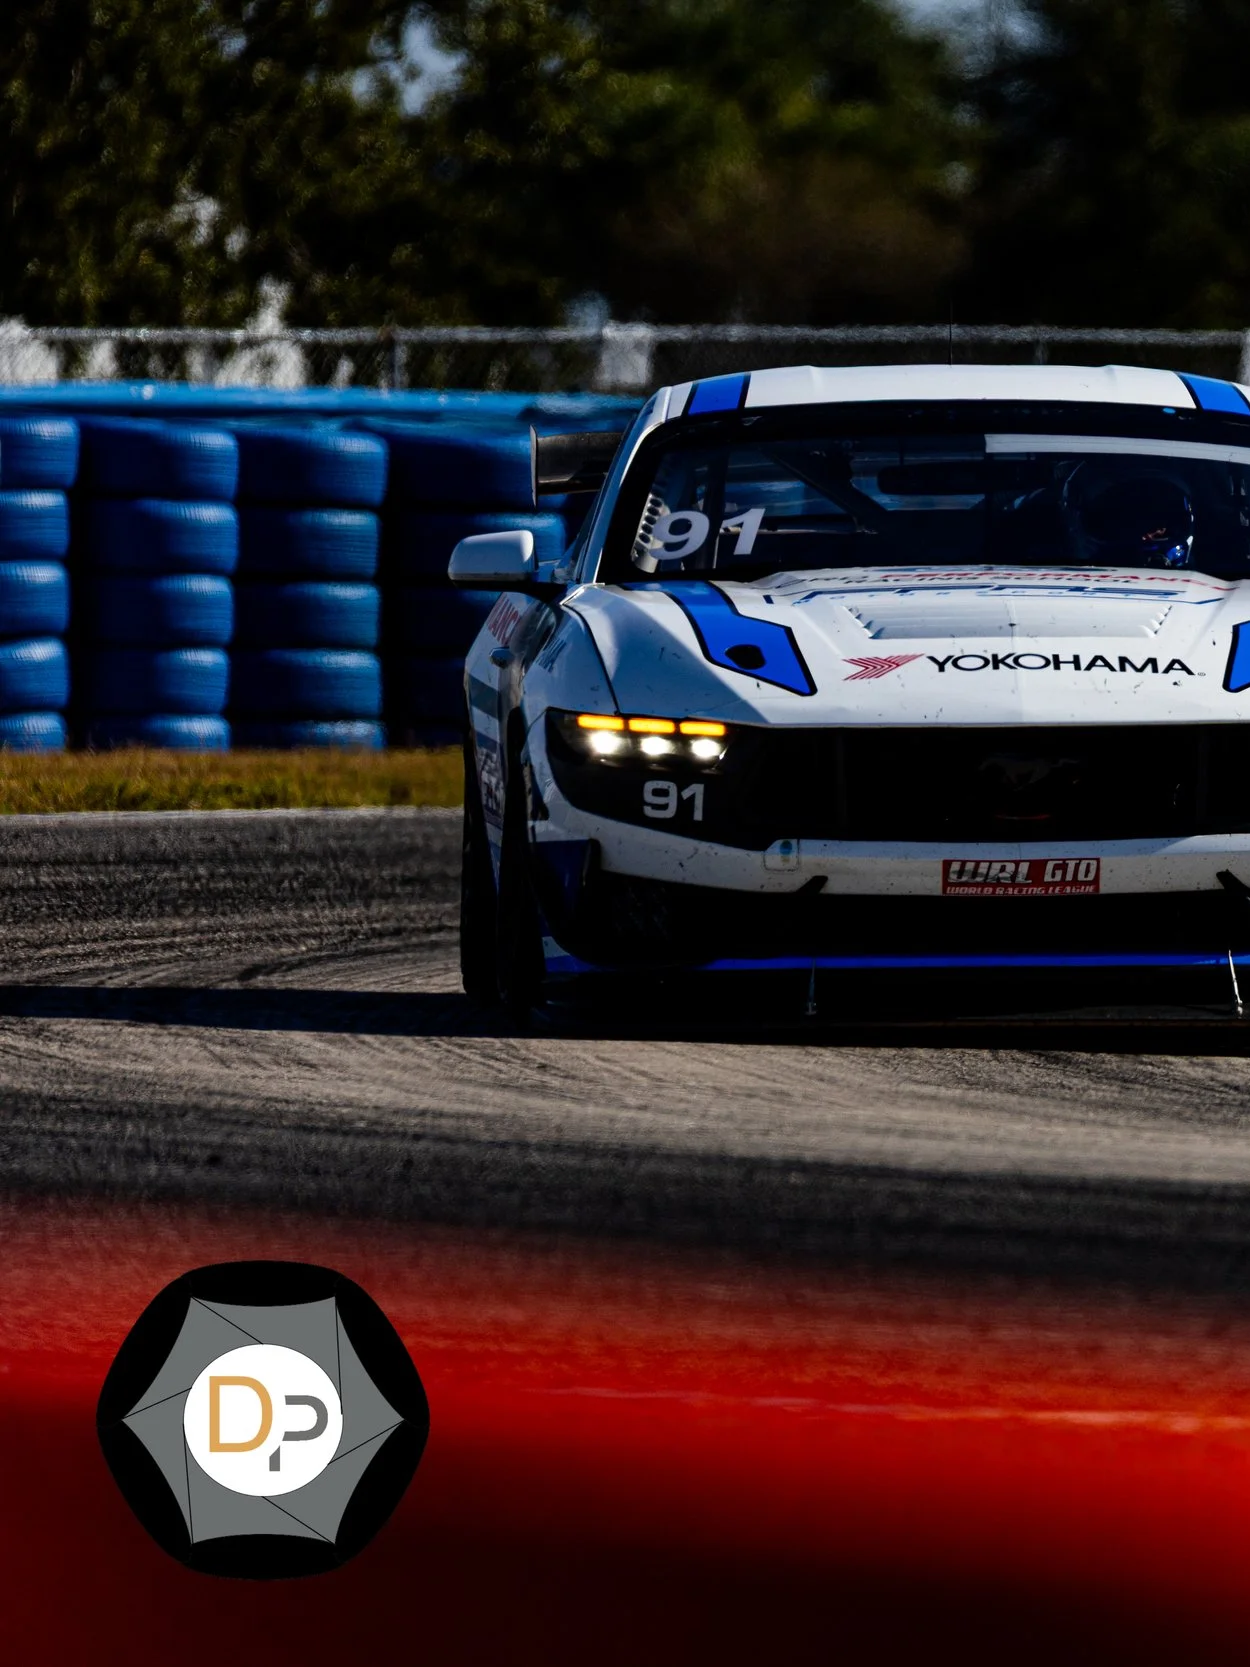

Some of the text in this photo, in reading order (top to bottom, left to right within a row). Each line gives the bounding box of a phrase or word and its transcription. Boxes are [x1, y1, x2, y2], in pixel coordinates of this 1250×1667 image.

[647, 507, 766, 560] 91
[926, 652, 1196, 676] YOKOHAMA
[643, 779, 705, 822] 91
[947, 860, 1033, 884] WRL
[946, 884, 1096, 895] WORLD RACING LEAGUE
